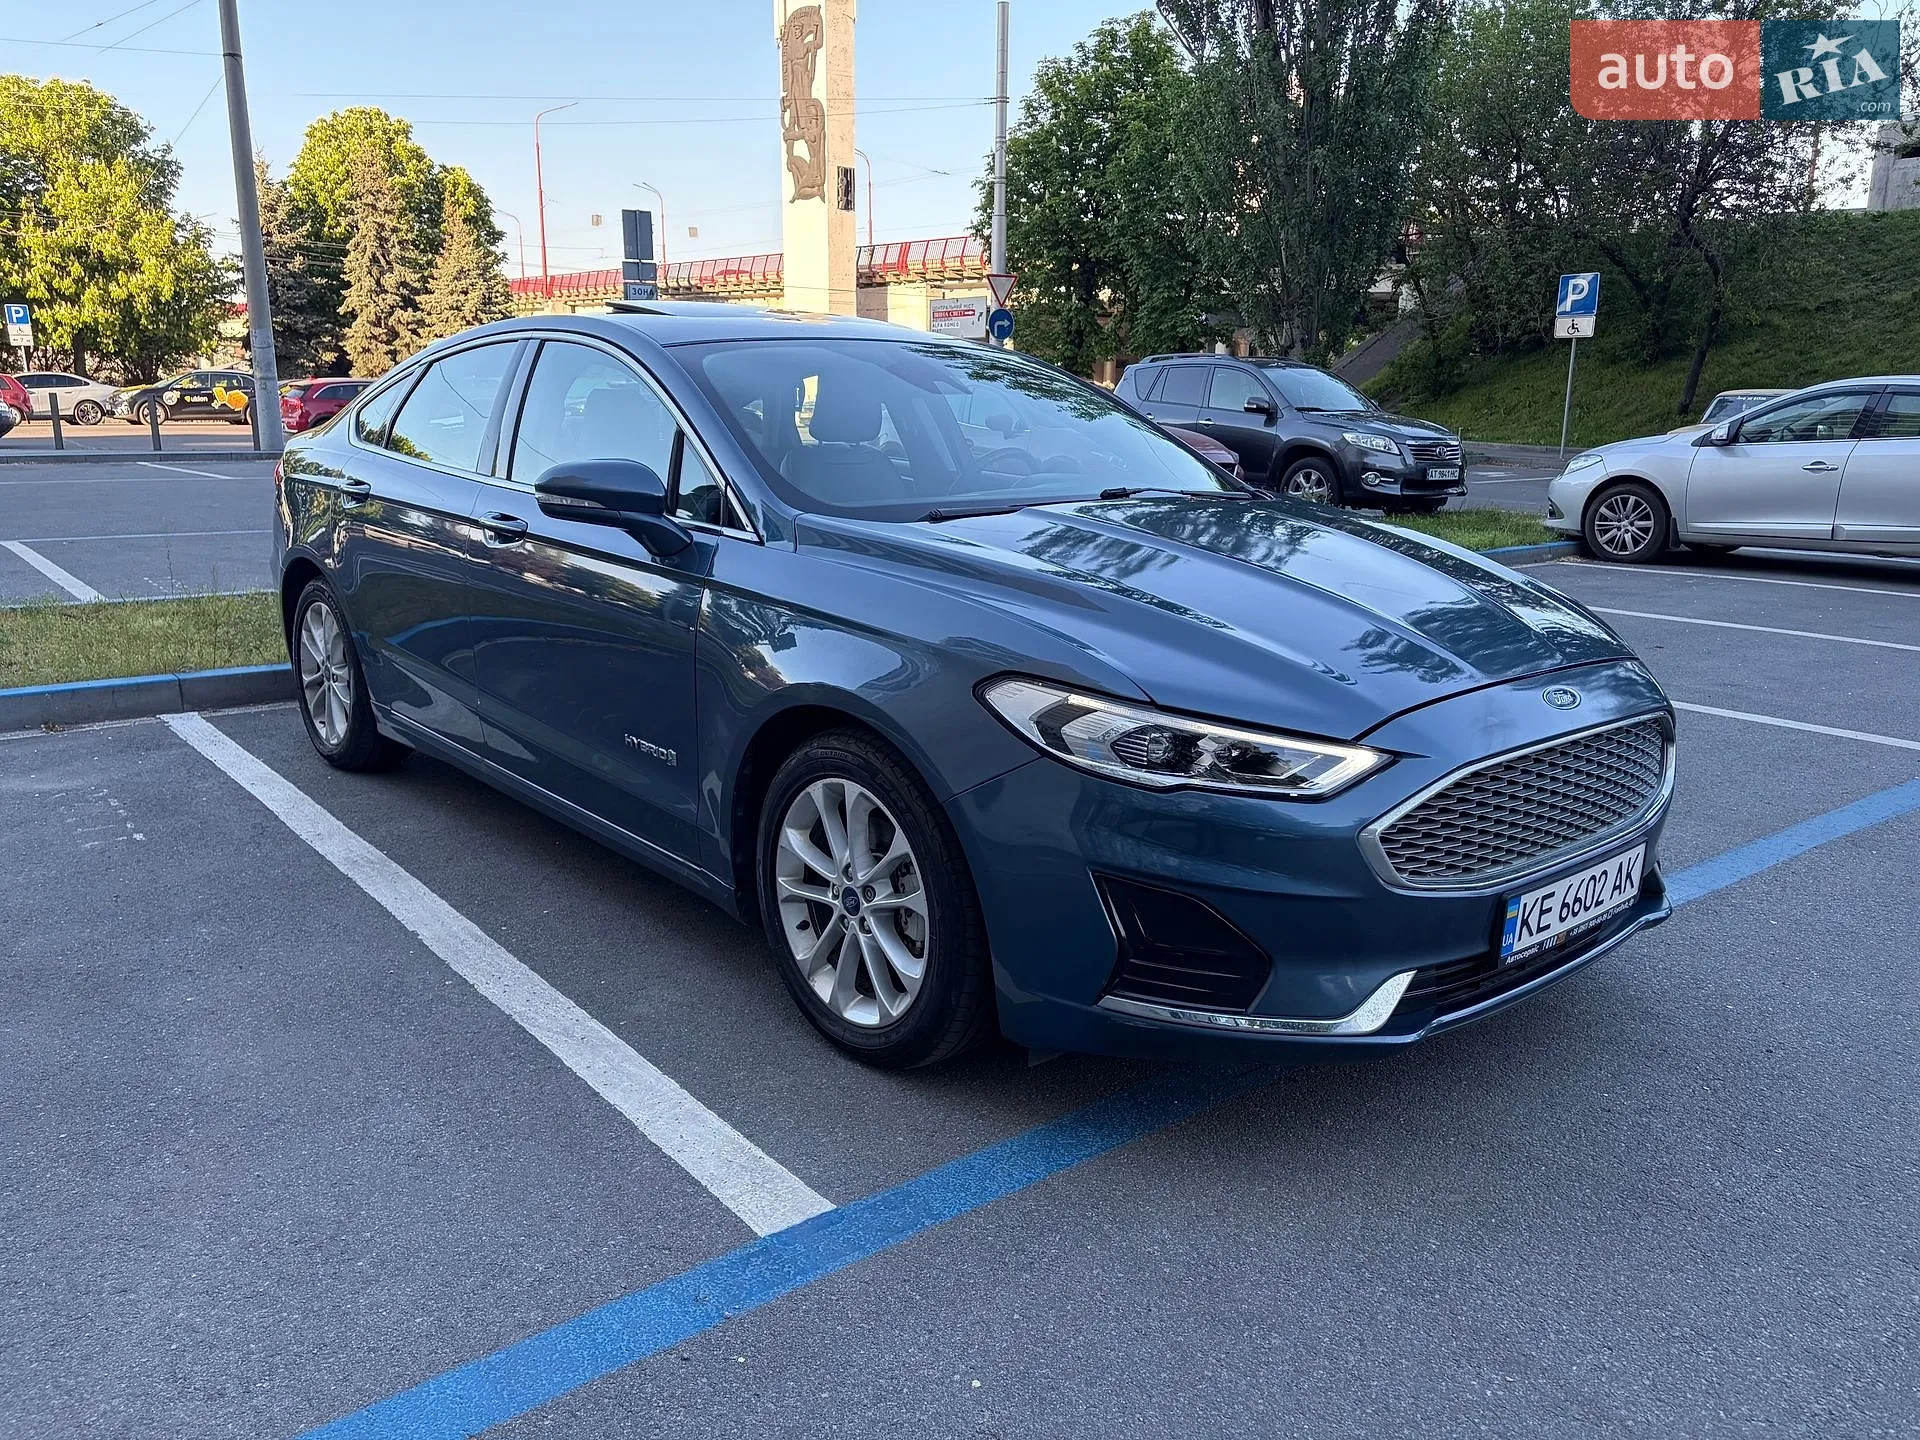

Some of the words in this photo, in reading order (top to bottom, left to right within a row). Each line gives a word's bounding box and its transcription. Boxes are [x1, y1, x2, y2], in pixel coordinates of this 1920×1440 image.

[632, 287, 655, 297] ЗОНА
[1565, 278, 1589, 312] P
[11, 306, 24, 323] P
[624, 733, 668, 760] HYBRID
[1517, 891, 1556, 942] KE
[1558, 869, 1609, 923] 6602
[1610, 852, 1640, 901] AK
[1502, 932, 1513, 947] UA
